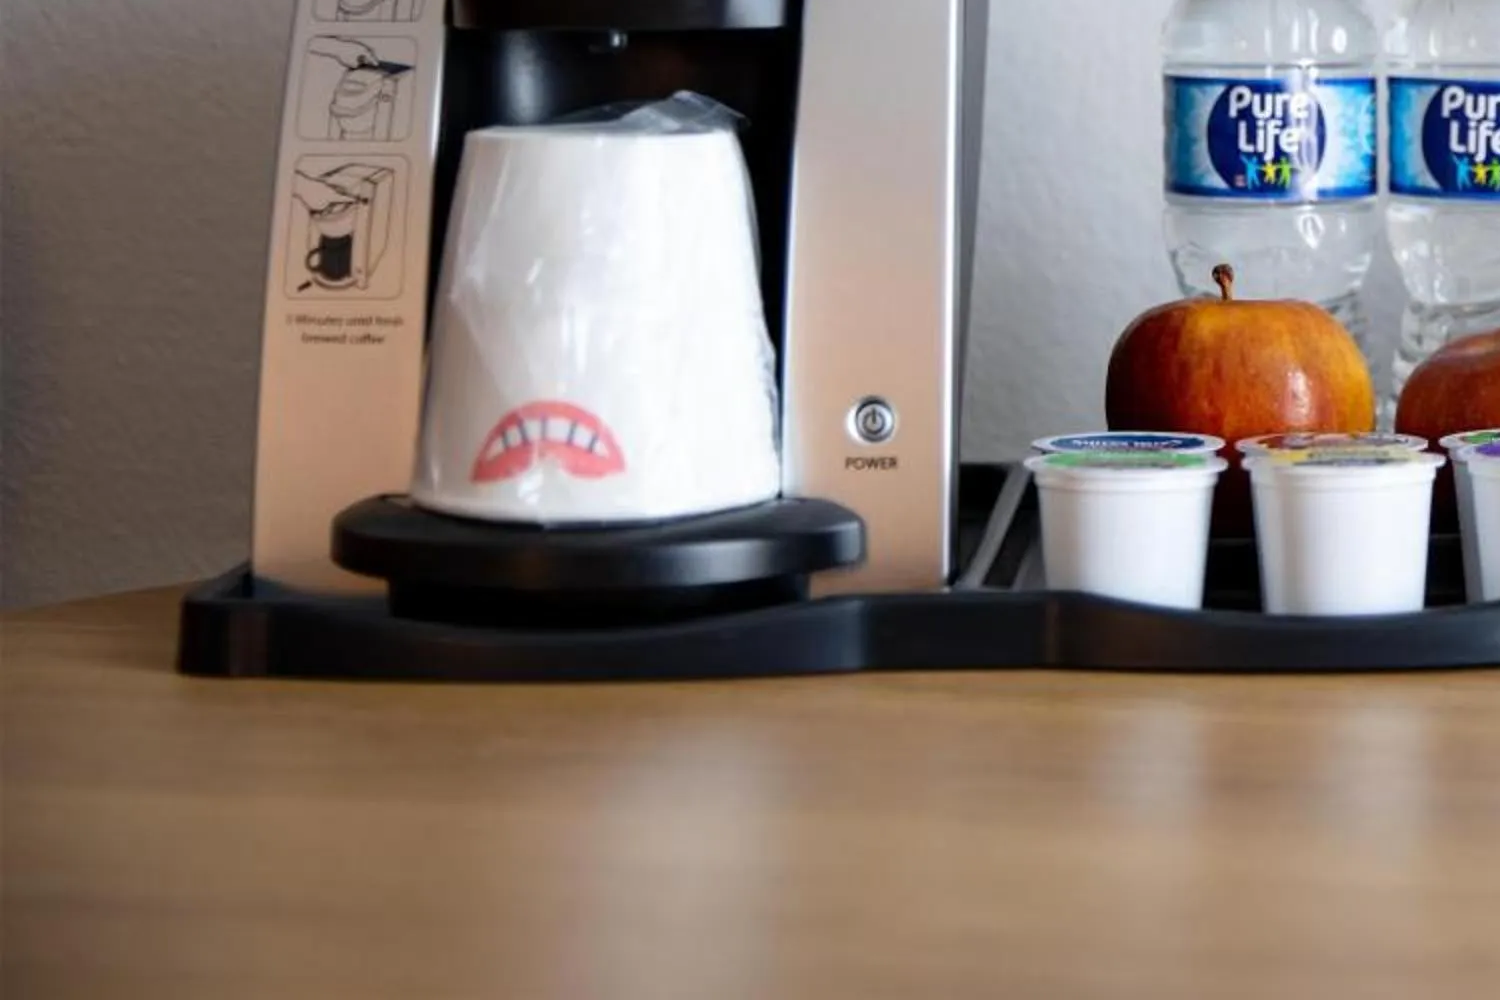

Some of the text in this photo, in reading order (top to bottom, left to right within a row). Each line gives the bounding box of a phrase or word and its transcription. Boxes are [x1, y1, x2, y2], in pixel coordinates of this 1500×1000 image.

[1229, 85, 1309, 119] Pure
[1238, 119, 1300, 162] Life
[845, 456, 897, 470] POWER
